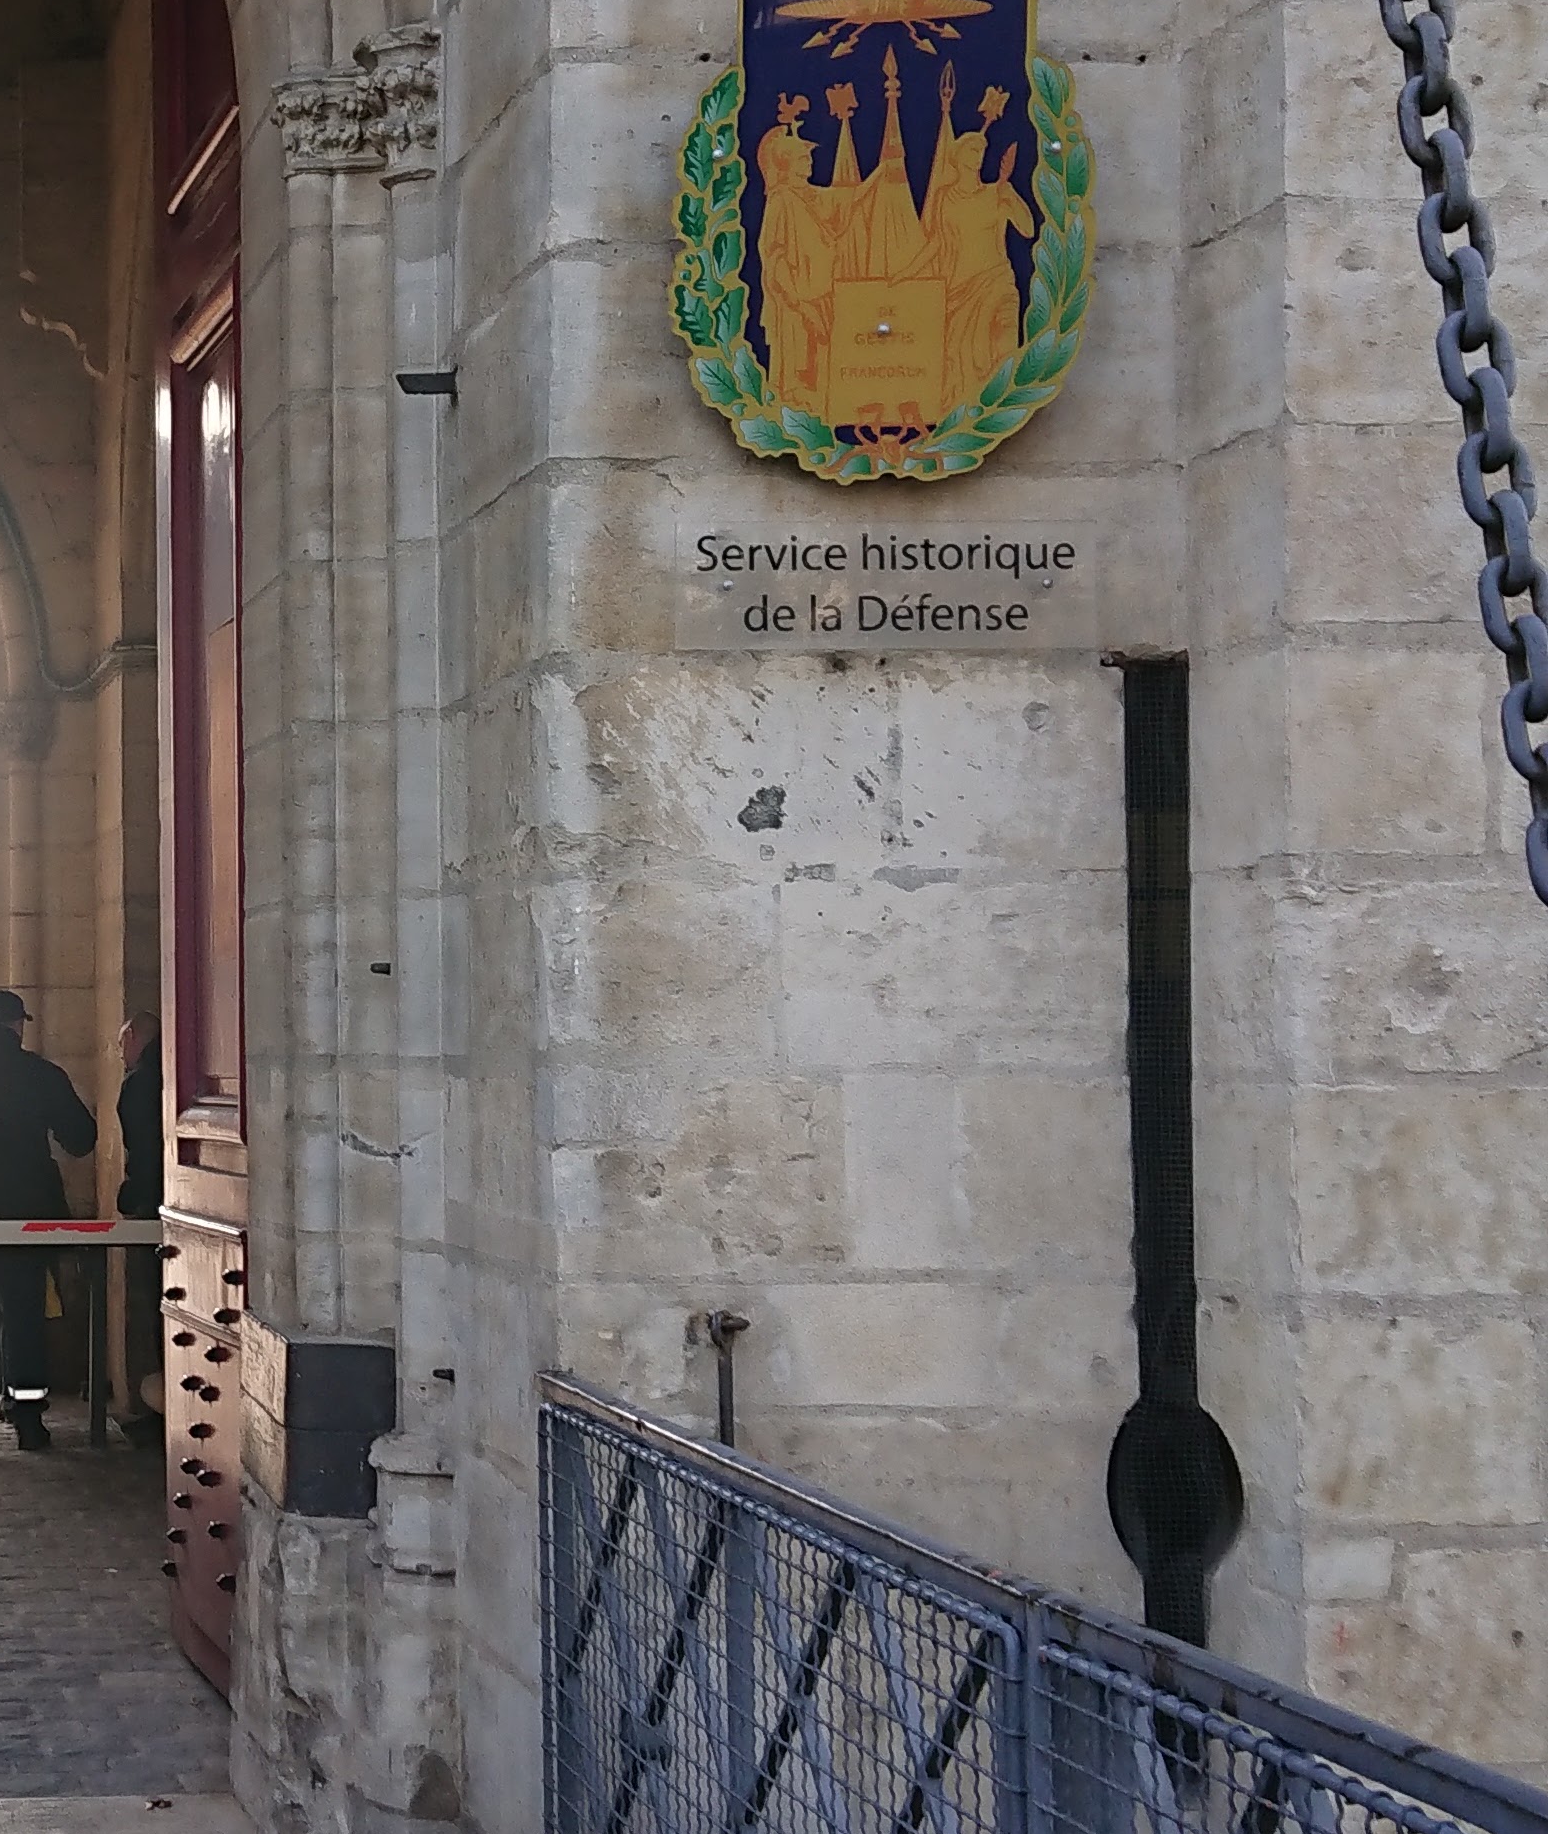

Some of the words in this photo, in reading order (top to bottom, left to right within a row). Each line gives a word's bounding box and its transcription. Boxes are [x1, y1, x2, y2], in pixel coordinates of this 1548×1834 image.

[696, 535, 847, 572] Service
[862, 533, 1076, 579] historique
[744, 594, 796, 632] de
[810, 594, 842, 632] la
[858, 594, 1029, 632] Défense
